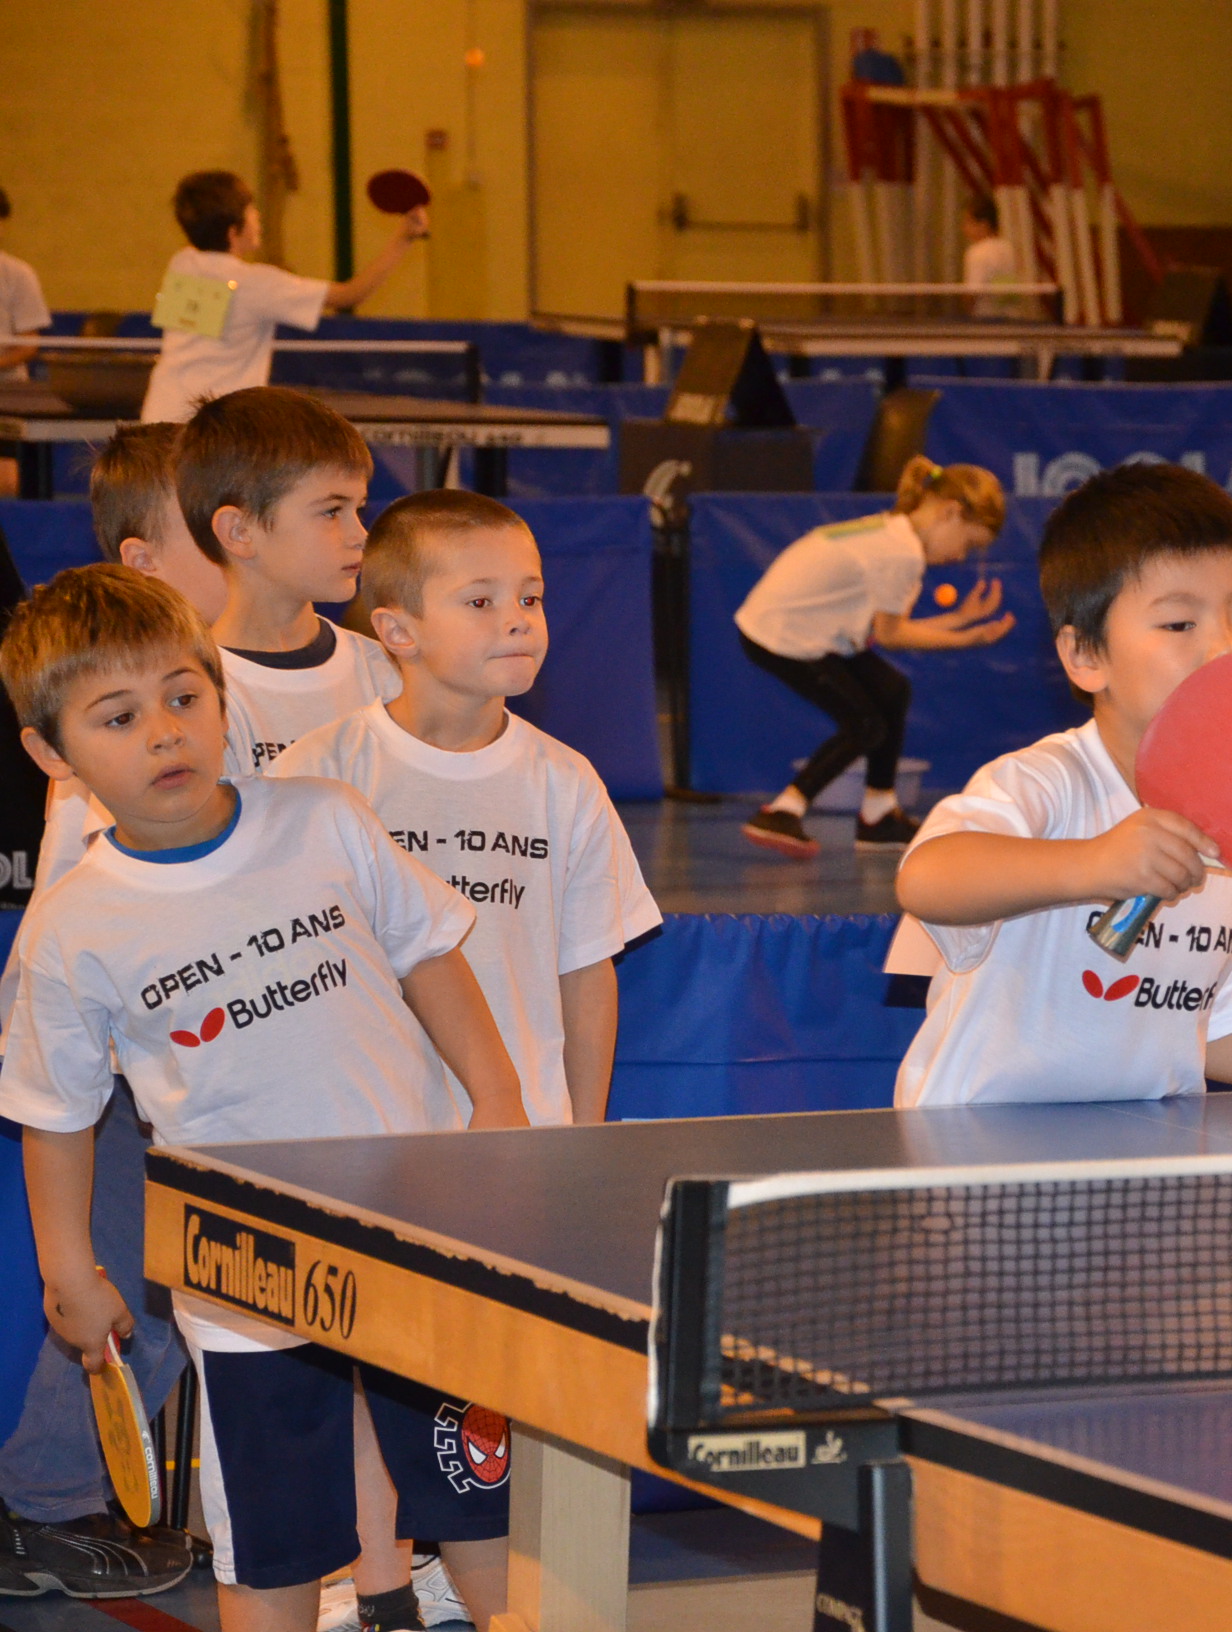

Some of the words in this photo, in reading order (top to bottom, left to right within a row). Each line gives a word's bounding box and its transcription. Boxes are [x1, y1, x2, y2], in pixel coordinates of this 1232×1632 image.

[388, 830, 429, 853] EN
[453, 829, 486, 852] 10
[491, 831, 549, 860] ANS
[446, 875, 526, 910] tterfly
[1186, 925, 1213, 953] 10
[140, 952, 225, 1011] OPEN
[246, 927, 285, 958] 10
[291, 904, 346, 945] ANS
[226, 958, 348, 1030] Butterfly
[1133, 977, 1218, 1012] Butterf
[186, 1213, 294, 1322] Cornilleau
[303, 1259, 357, 1340] 650
[692, 1440, 800, 1467] Cornilleau
[144, 1446, 159, 1500] cornilleau
